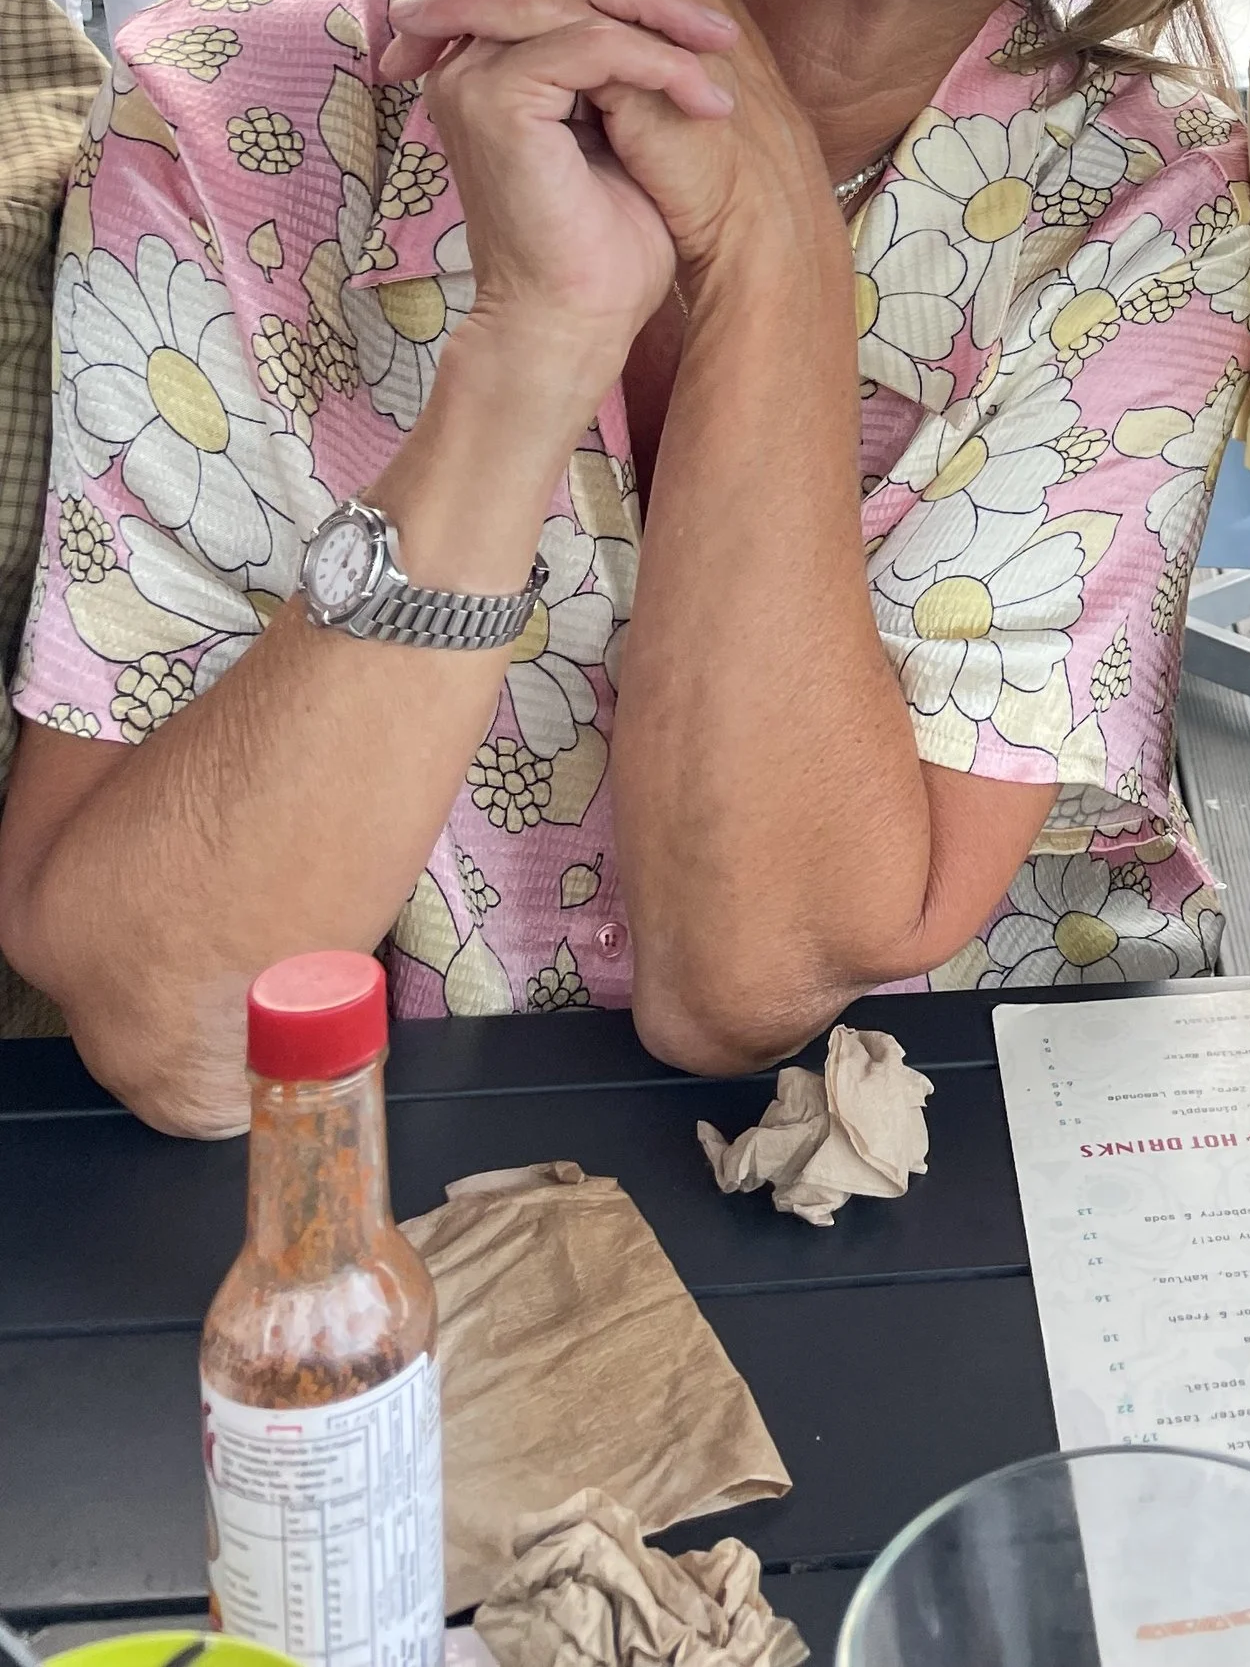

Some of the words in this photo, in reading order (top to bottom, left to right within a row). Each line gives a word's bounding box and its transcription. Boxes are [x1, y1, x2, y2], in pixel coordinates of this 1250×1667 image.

[1078, 1136, 1184, 1159] DRINKS
[1190, 1132, 1238, 1150] HOT
[1142, 1213, 1176, 1224] soda
[1190, 1233, 1231, 1246] not!?
[1166, 1311, 1211, 1324] fresh
[1183, 1377, 1247, 1394] special
[1155, 1413, 1201, 1426] taste
[1117, 1431, 1159, 1448] 17.5
